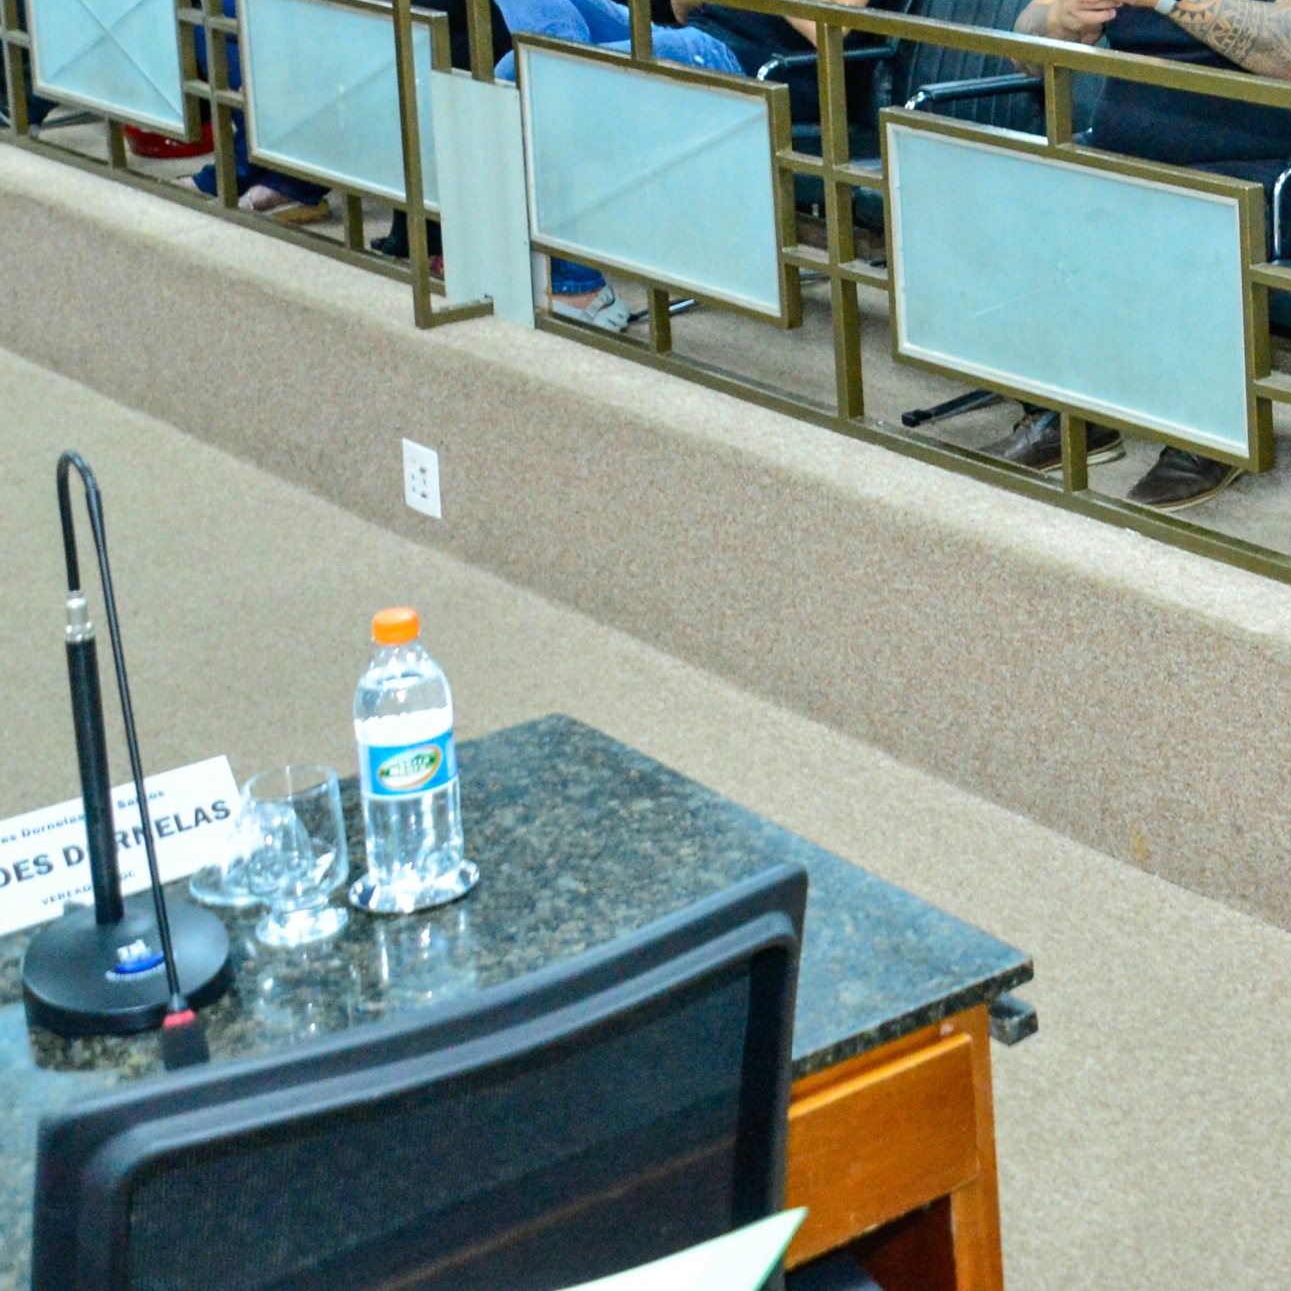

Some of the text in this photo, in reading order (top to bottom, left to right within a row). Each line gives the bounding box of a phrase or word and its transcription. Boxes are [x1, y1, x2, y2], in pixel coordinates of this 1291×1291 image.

[117, 790, 164, 808] Saos
[62, 799, 232, 867] DRNELAS
[41, 883, 93, 905] VEREAD
